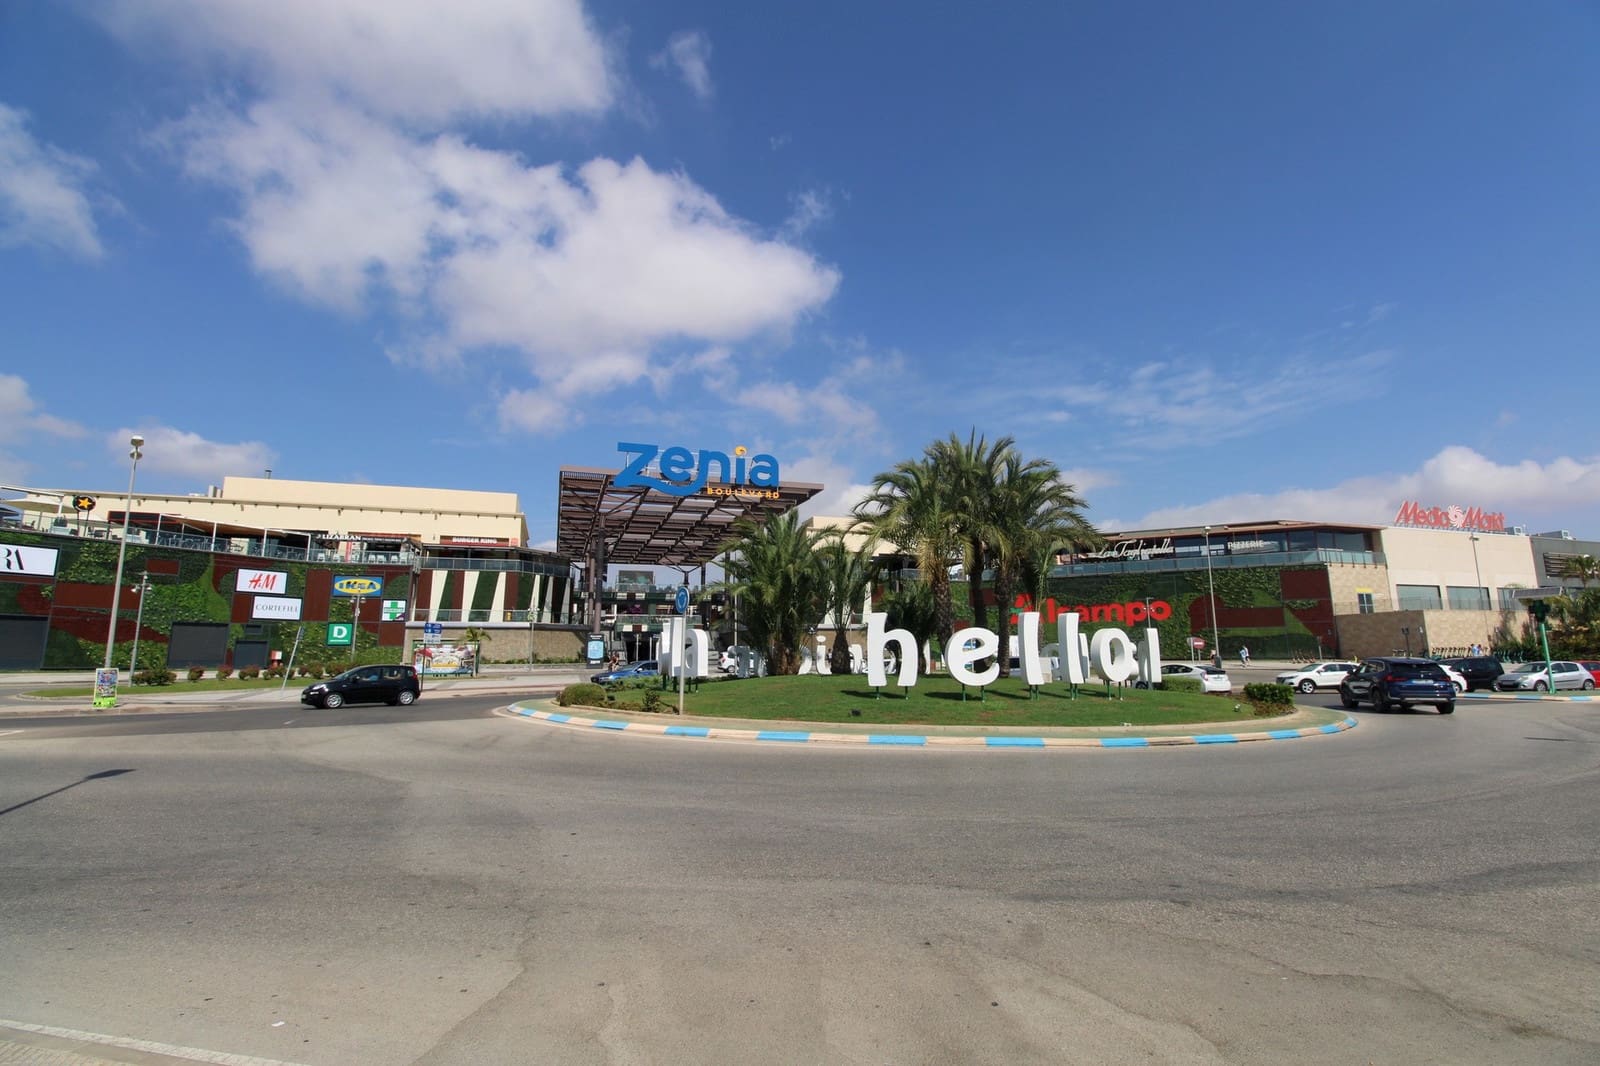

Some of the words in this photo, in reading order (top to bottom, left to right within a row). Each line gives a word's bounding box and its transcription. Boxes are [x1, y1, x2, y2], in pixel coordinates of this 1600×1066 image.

[706, 486, 780, 499] BOULEVARD
[1395, 500, 1450, 529] Media
[248, 573, 277, 591] H&M
[338, 581, 377, 590] IKEA
[332, 625, 348, 639] D
[867, 611, 1130, 687] hello
